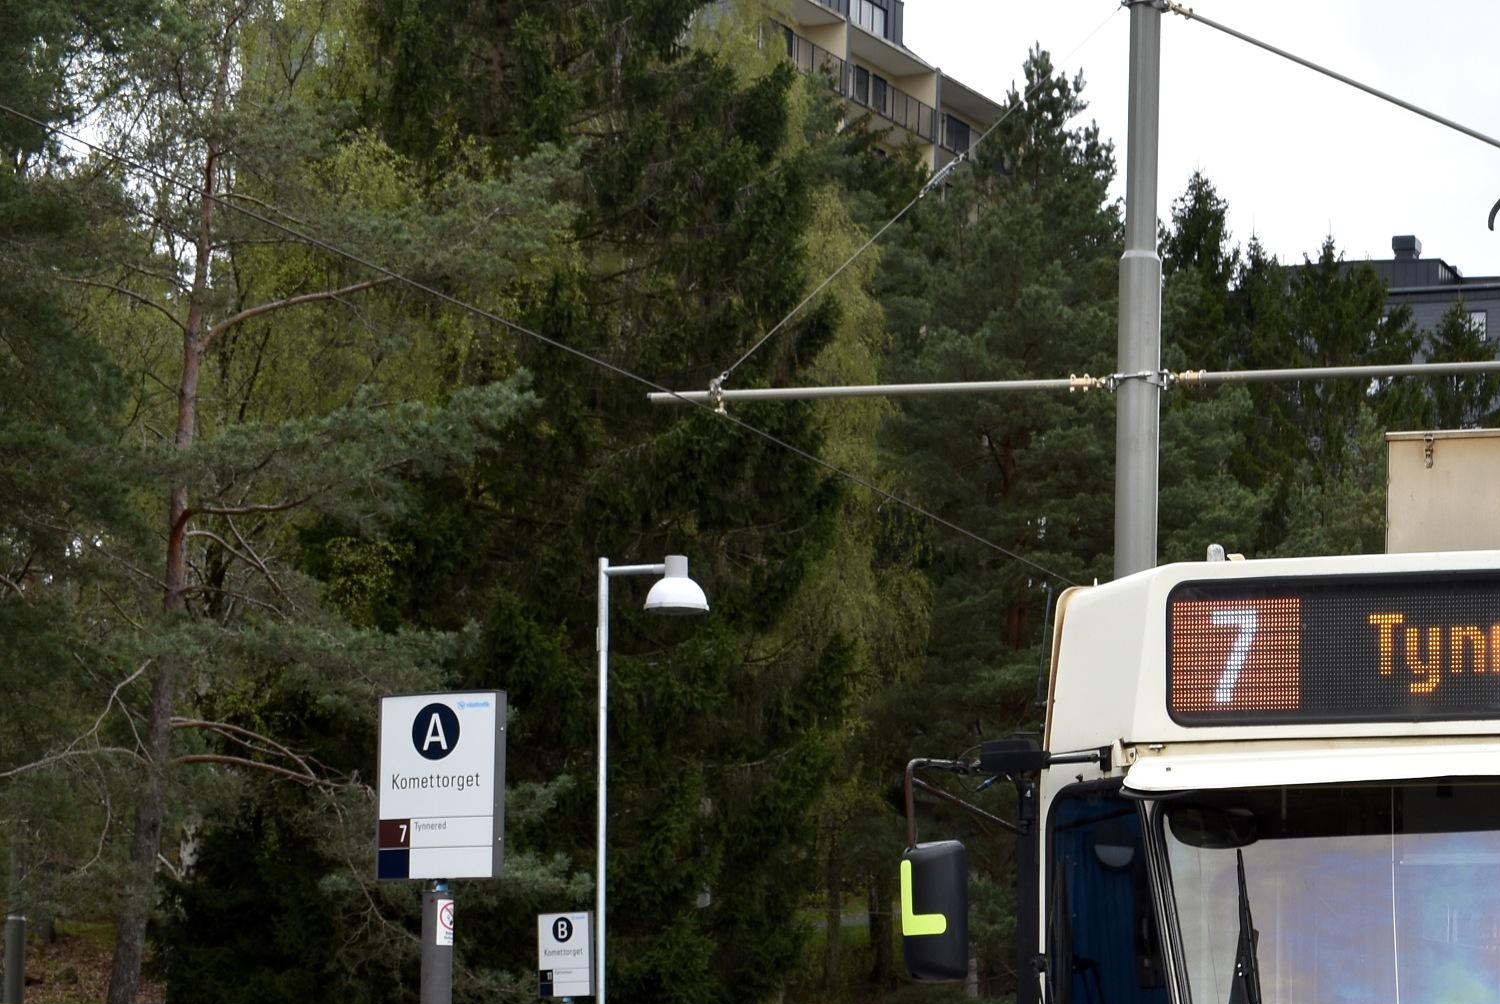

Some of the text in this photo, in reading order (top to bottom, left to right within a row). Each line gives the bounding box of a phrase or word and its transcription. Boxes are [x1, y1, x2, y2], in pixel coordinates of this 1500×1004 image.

[1210, 609, 1258, 702] 7
[422, 712, 448, 751] A
[391, 772, 481, 791] Komettorget
[399, 820, 447, 843] 7 Tynnered
[557, 920, 568, 939] B
[543, 947, 583, 957] Komettorget
